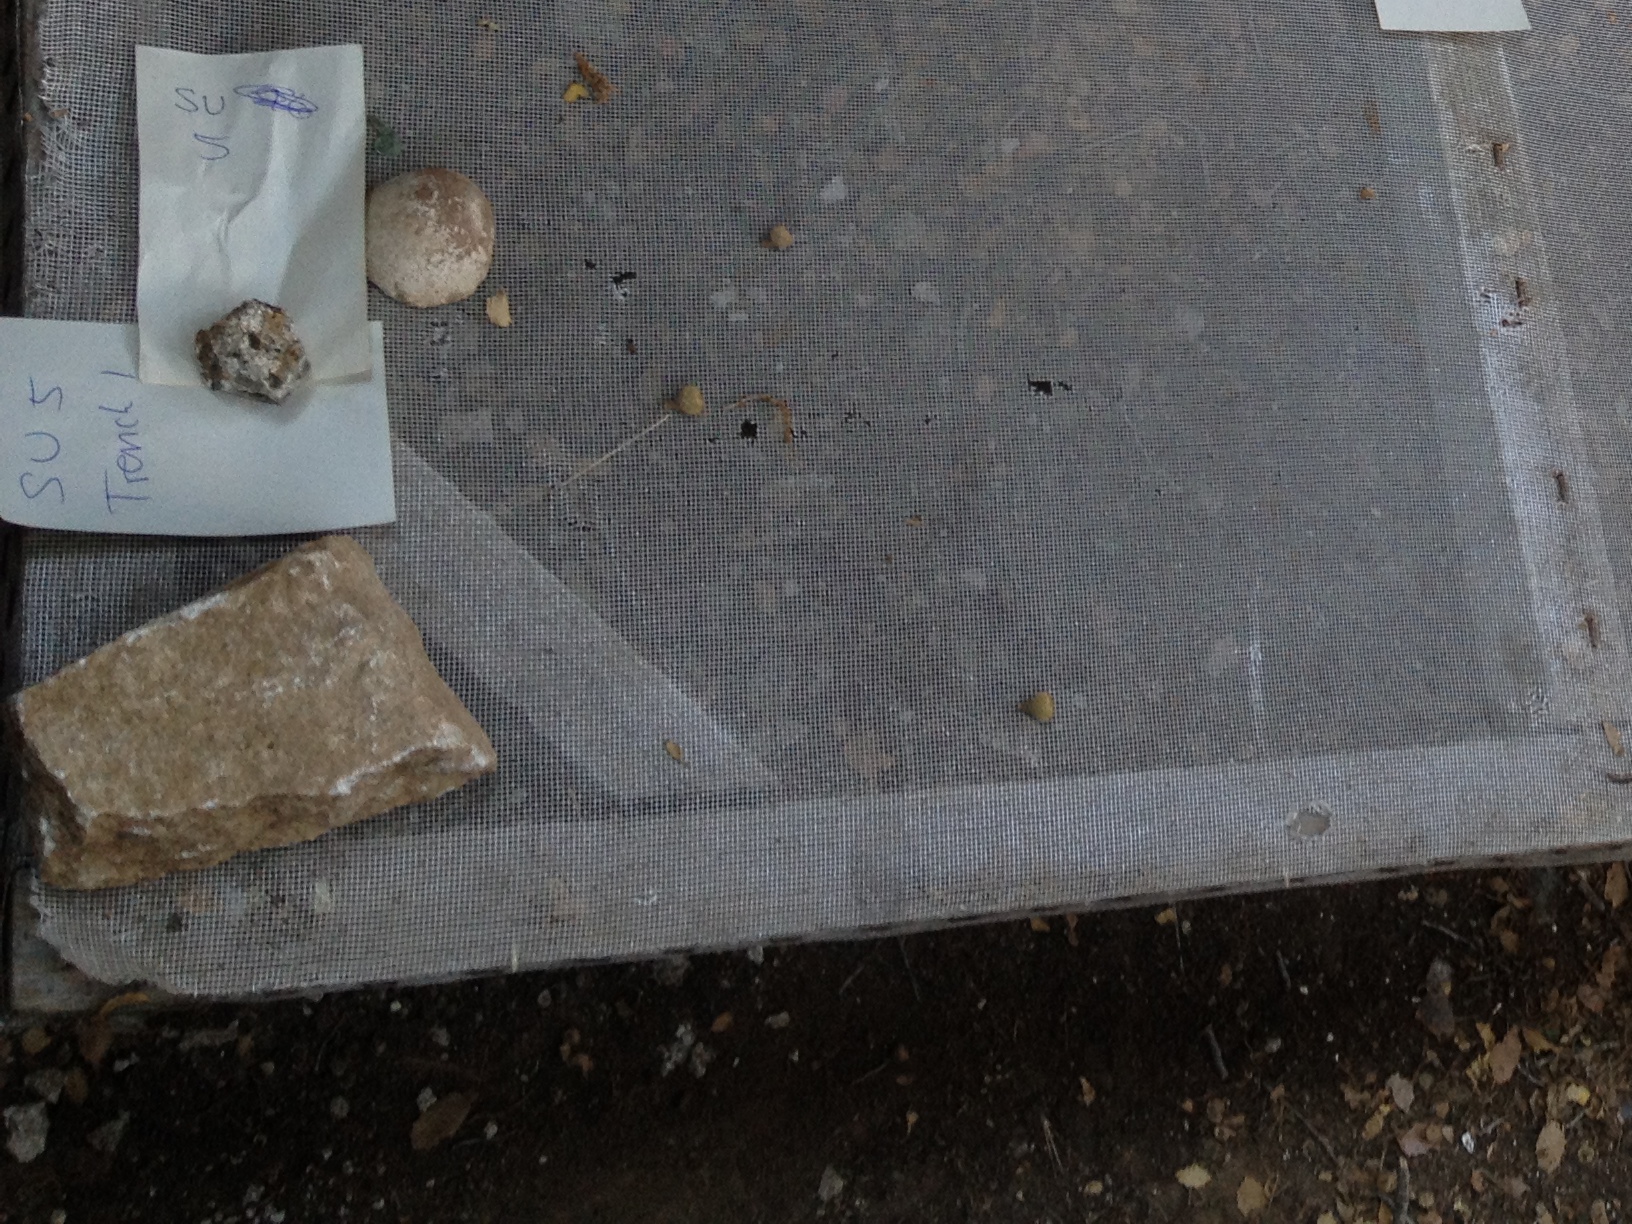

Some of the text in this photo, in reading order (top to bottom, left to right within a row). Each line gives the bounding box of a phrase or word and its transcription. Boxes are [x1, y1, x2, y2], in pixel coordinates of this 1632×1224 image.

[175, 87, 225, 116] SU
[20, 376, 65, 505] SU 5
[99, 399, 150, 515] Trench
